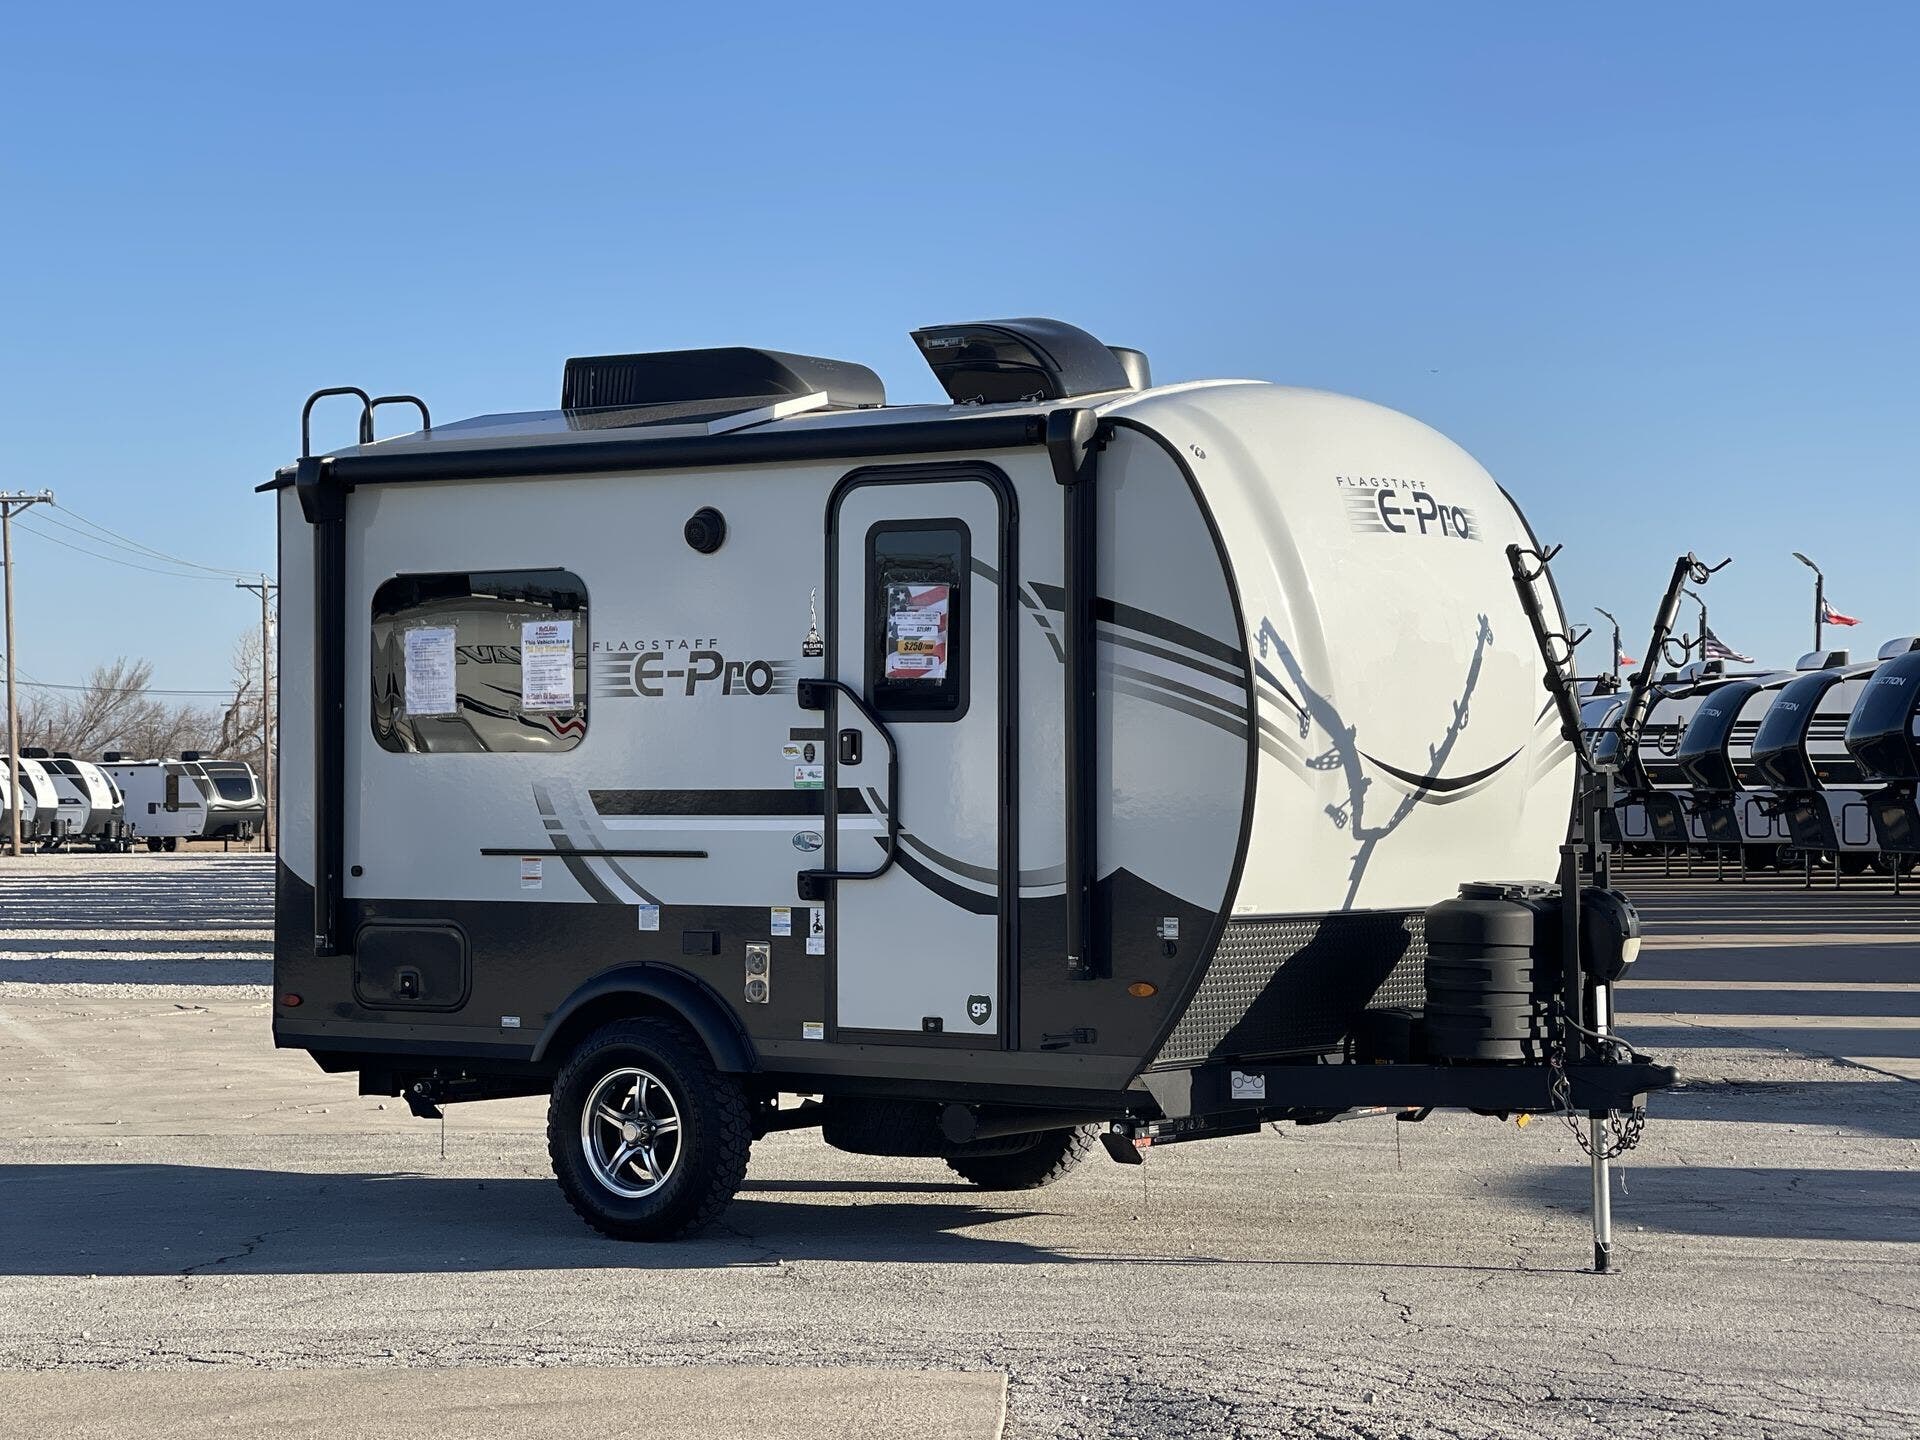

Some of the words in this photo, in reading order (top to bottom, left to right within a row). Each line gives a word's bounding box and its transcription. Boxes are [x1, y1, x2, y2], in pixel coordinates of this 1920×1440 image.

[1336, 476, 1426, 490] FLAGSTAFF
[1377, 488, 1470, 540] E-Pro
[592, 638, 718, 652] FLAGSTAFF
[634, 650, 774, 697] E-Pro
[972, 1003, 987, 1017] gs
